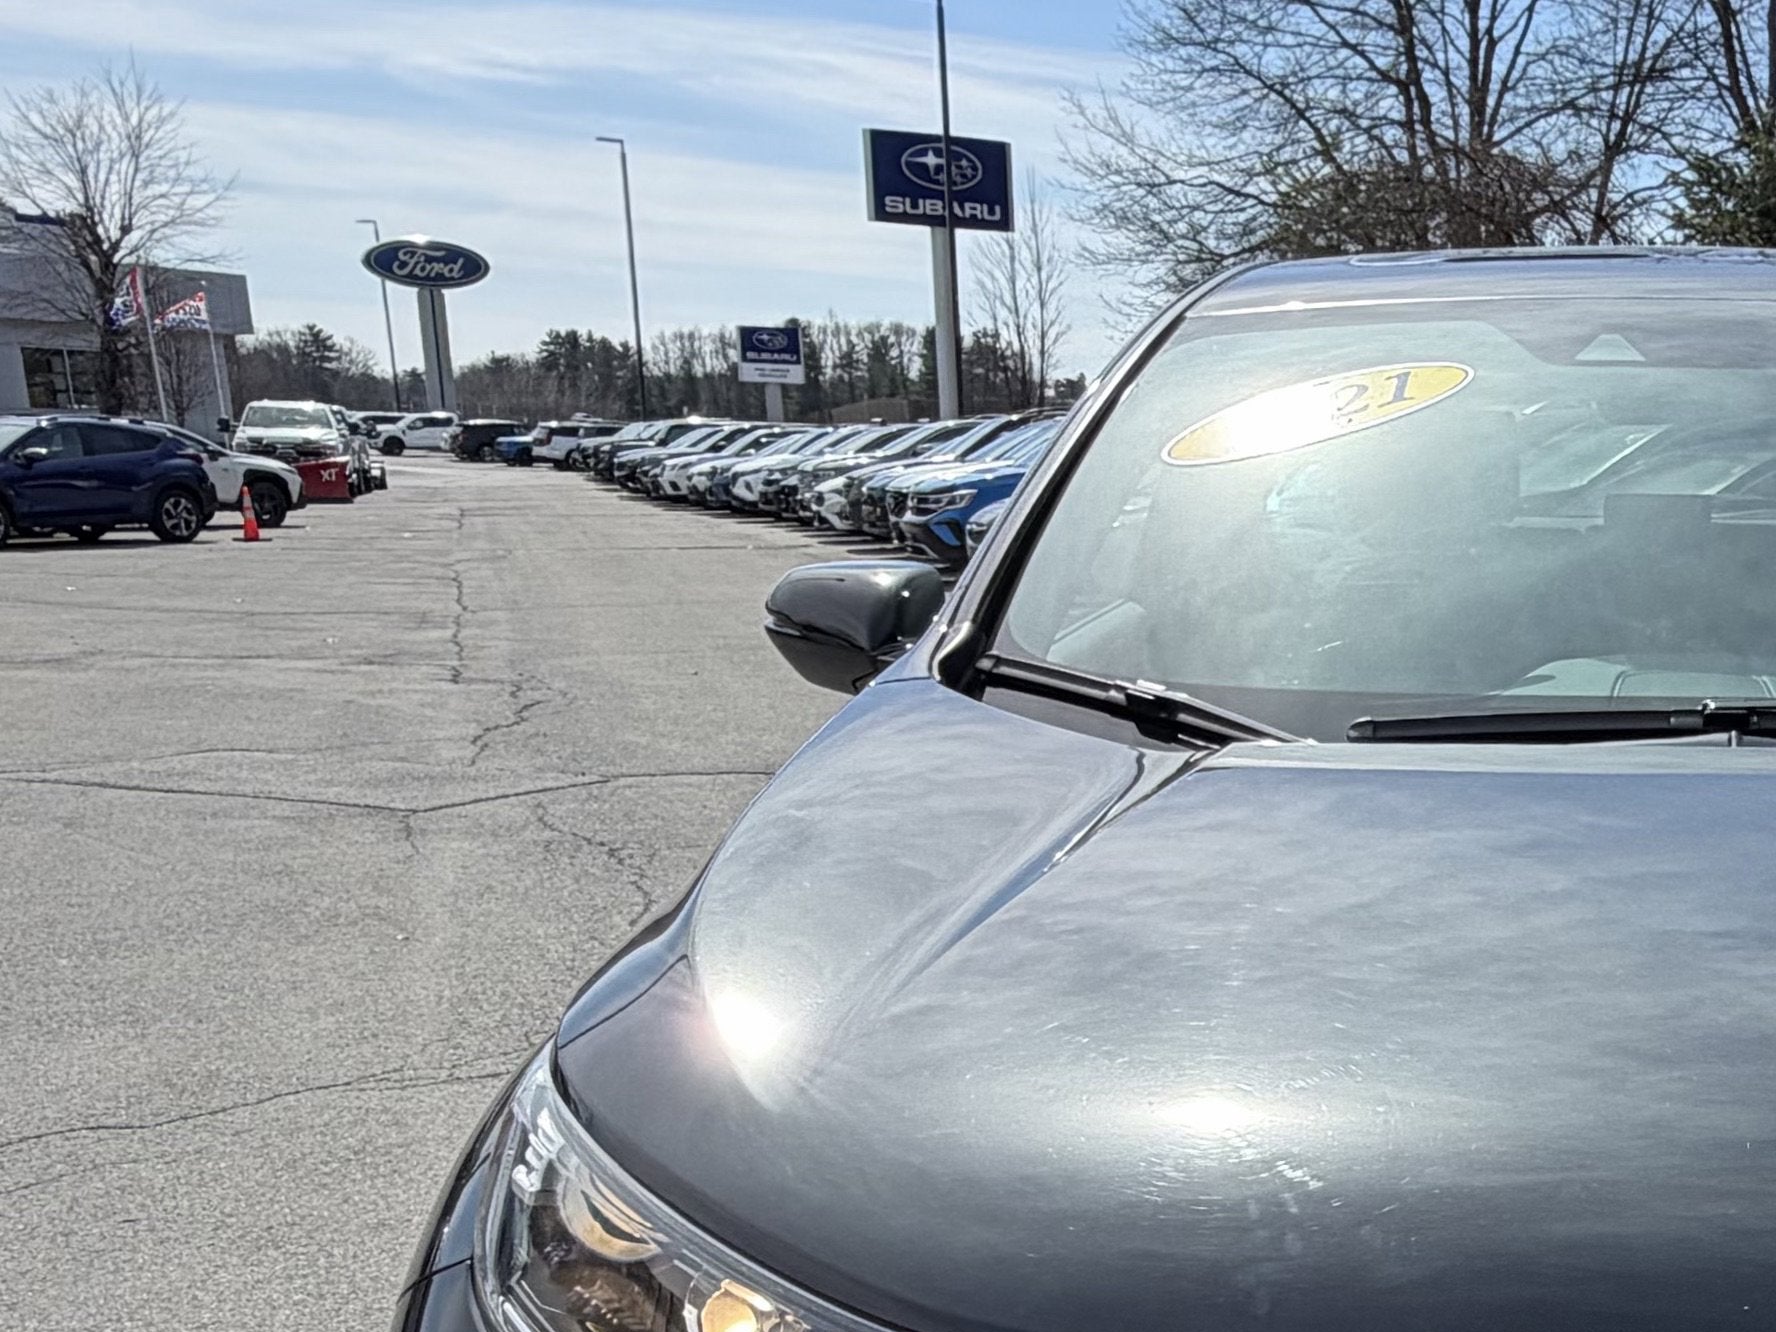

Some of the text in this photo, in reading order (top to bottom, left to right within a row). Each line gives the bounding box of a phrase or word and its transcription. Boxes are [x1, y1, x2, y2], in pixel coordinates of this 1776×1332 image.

[884, 195, 1001, 221] SUBARU
[392, 247, 465, 279] Ford
[320, 468, 340, 482] XT
